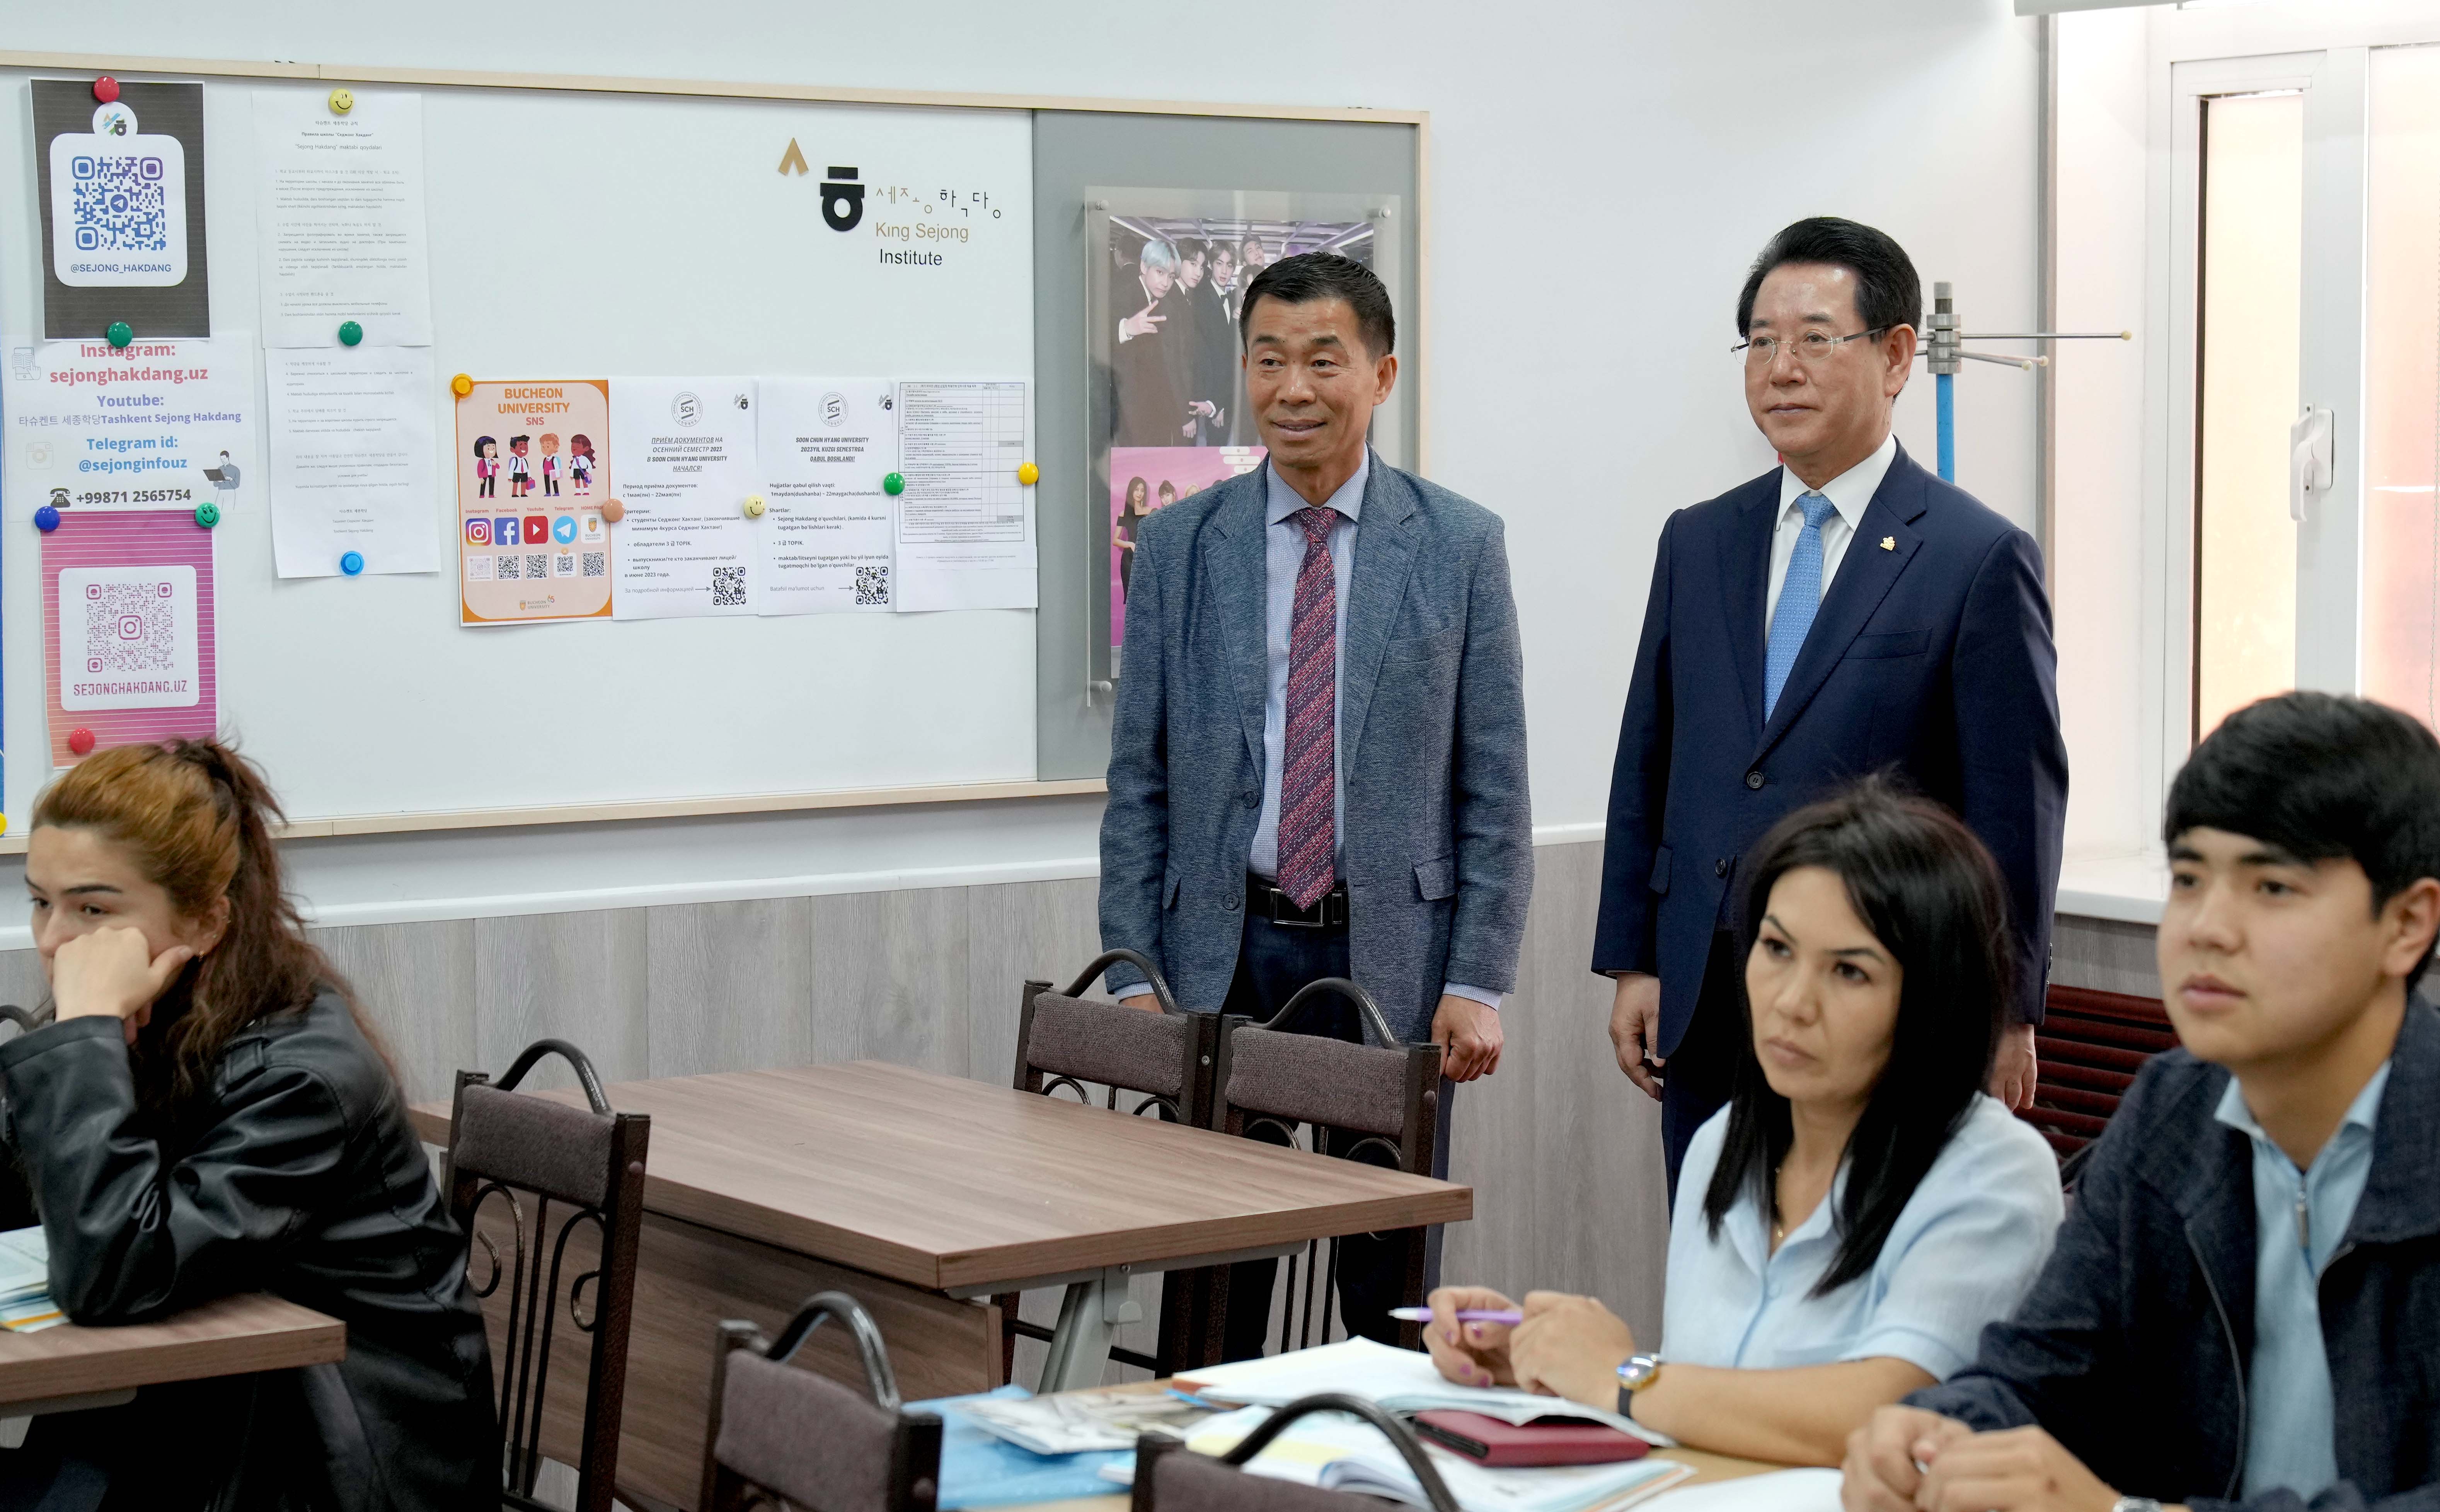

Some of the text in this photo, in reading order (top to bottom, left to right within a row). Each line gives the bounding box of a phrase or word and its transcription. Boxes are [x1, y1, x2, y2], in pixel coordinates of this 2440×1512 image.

[876, 186, 1001, 218] 세종학당
[916, 223, 968, 243] Sejong
[880, 249, 942, 266] Institute
[71, 264, 171, 274] @SEJONG_HAKDANG
[81, 342, 175, 359] Instagram:
[50, 367, 208, 387] sejonghakdang.uz
[97, 394, 164, 407] Youtube:
[504, 387, 562, 399] BUCHEON
[498, 402, 570, 414] UNIVERSITY
[19, 415, 59, 427] 타슈켄트
[155, 413, 191, 425] Sejong
[193, 411, 241, 423] Hakdang
[526, 417, 544, 426] SNS
[87, 436, 178, 453] Telegram id:
[79, 457, 187, 474] @sejonginfouz
[77, 489, 191, 504] +99871 2565754
[74, 680, 187, 696] SEJONGHAKDANG.UZ
